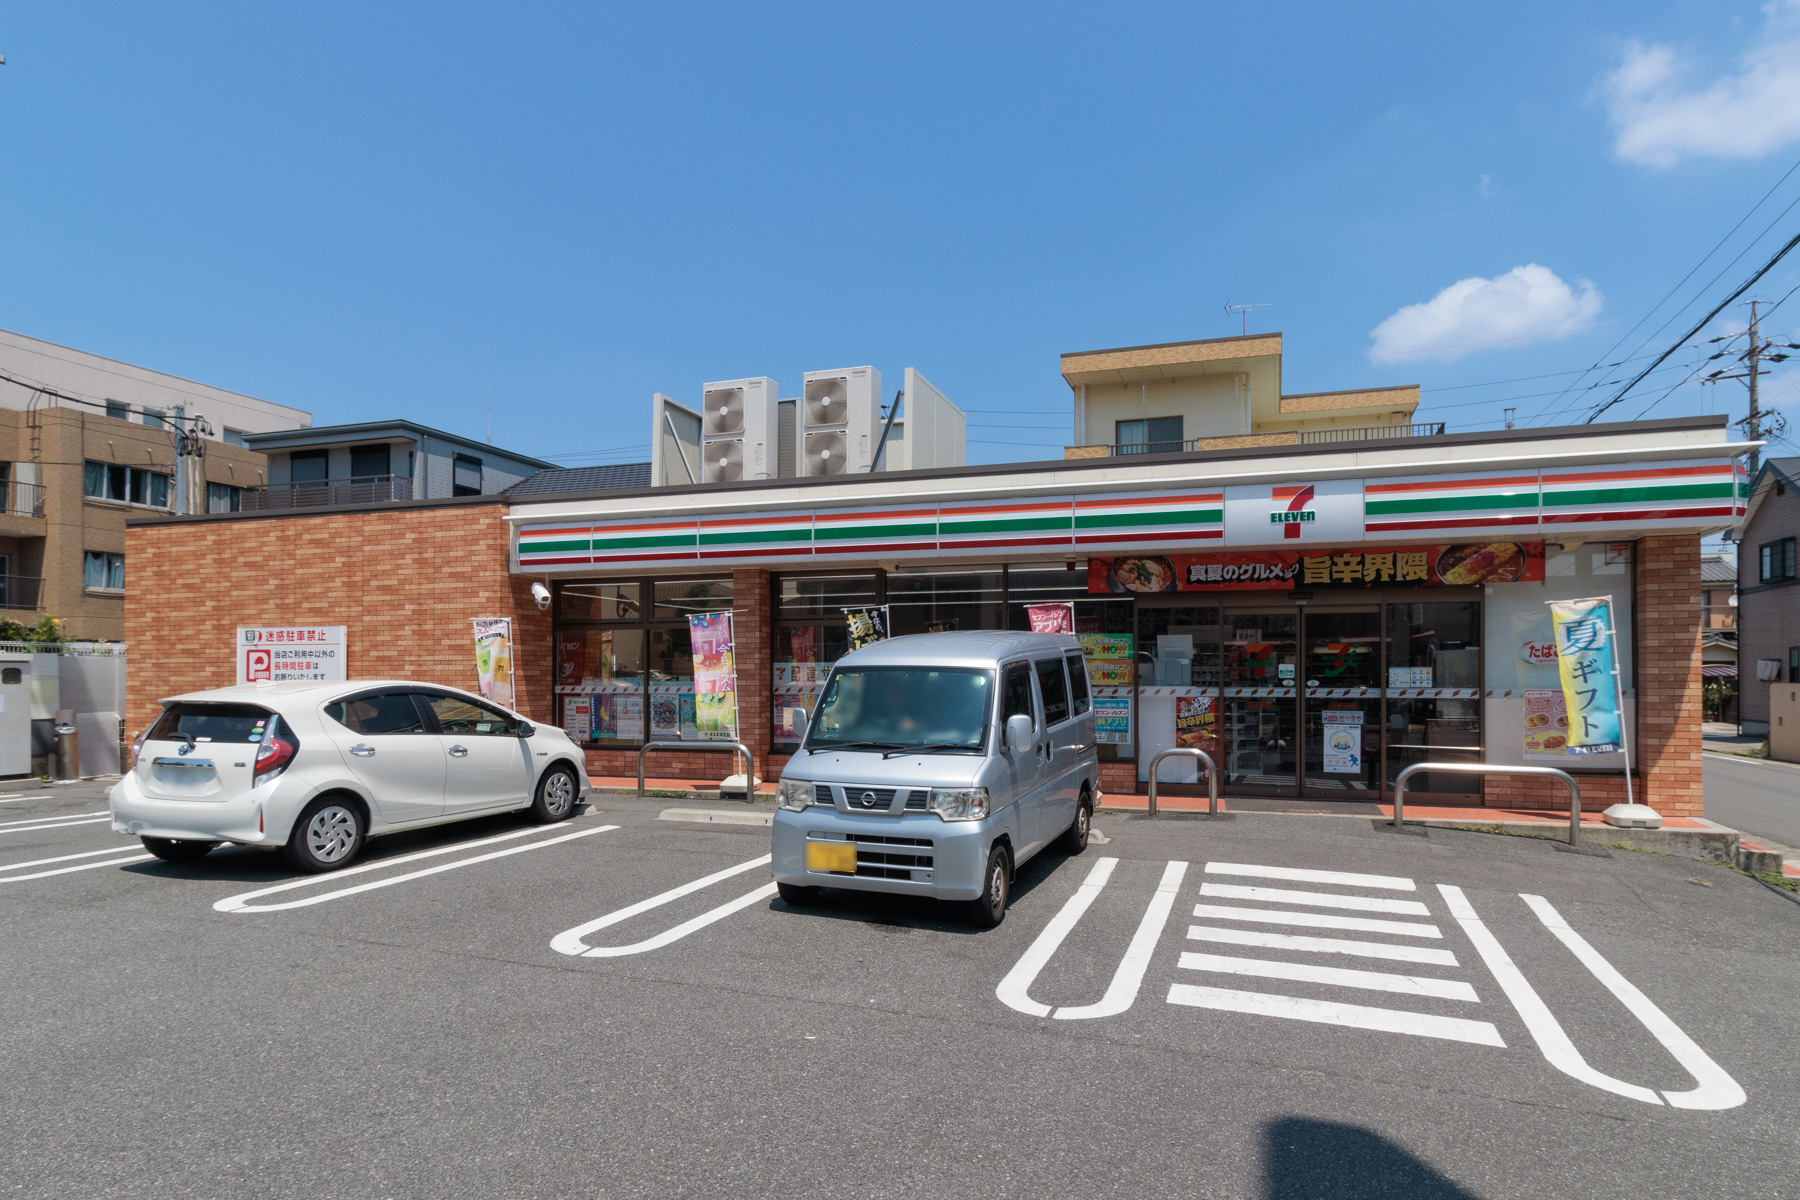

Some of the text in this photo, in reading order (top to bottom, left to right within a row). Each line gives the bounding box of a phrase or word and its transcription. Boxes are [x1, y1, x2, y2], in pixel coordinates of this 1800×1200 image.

[1190, 562, 1284, 582] 真夏のグルメ
[1303, 551, 1429, 584] 旨辛界隈
[265, 630, 326, 642] 迷惑駐車禁止
[274, 650, 335, 659] 当店ご利用中以外の
[274, 661, 319, 671] 長時間駐車は
[274, 673, 325, 681] お断りいたします
